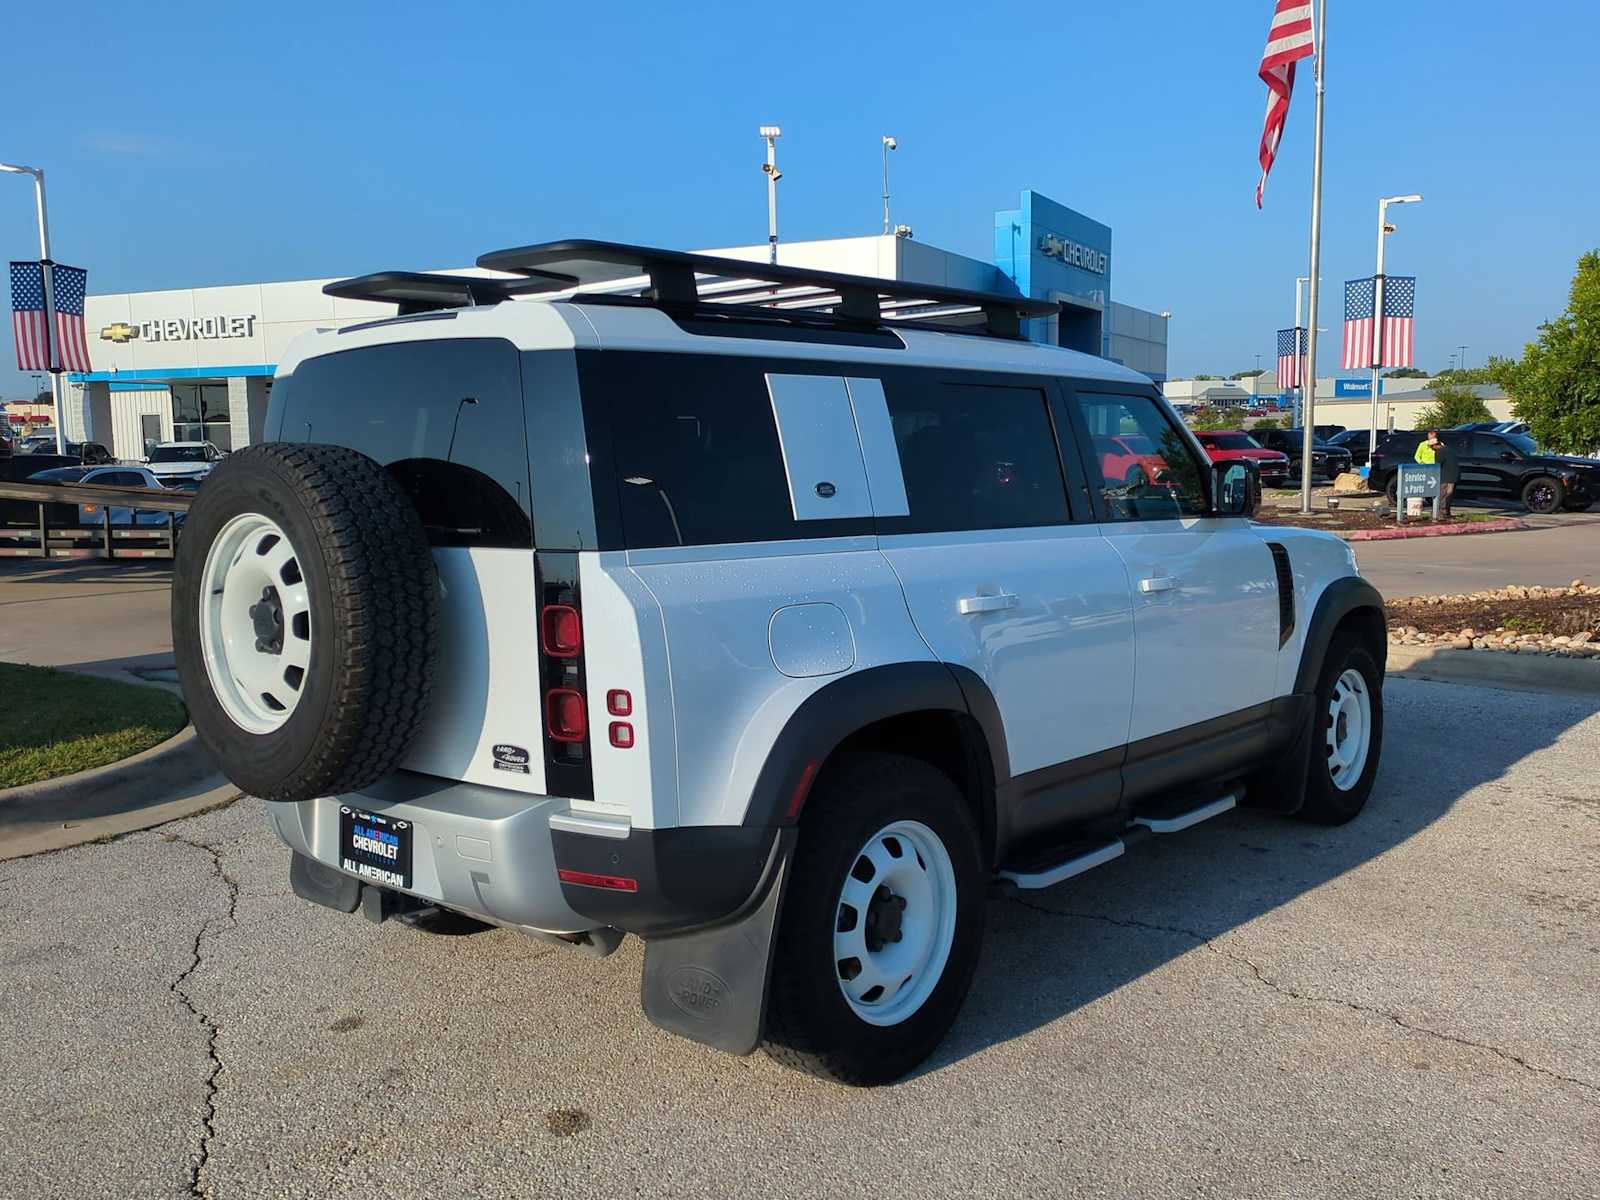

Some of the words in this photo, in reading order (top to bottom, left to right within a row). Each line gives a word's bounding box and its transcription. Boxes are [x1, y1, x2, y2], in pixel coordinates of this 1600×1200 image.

[1064, 239, 1107, 274] CHEVROLET
[139, 314, 256, 342] CHEVROLET
[1343, 383, 1368, 391] Walmart
[1404, 473, 1426, 482] Service
[1409, 485, 1425, 494] Parts
[353, 824, 365, 836] ALL
[366, 828, 399, 846] AMERICAN
[353, 835, 399, 860] CHEVROLET
[343, 858, 358, 873] ALL
[358, 864, 404, 887] AMERICAN
